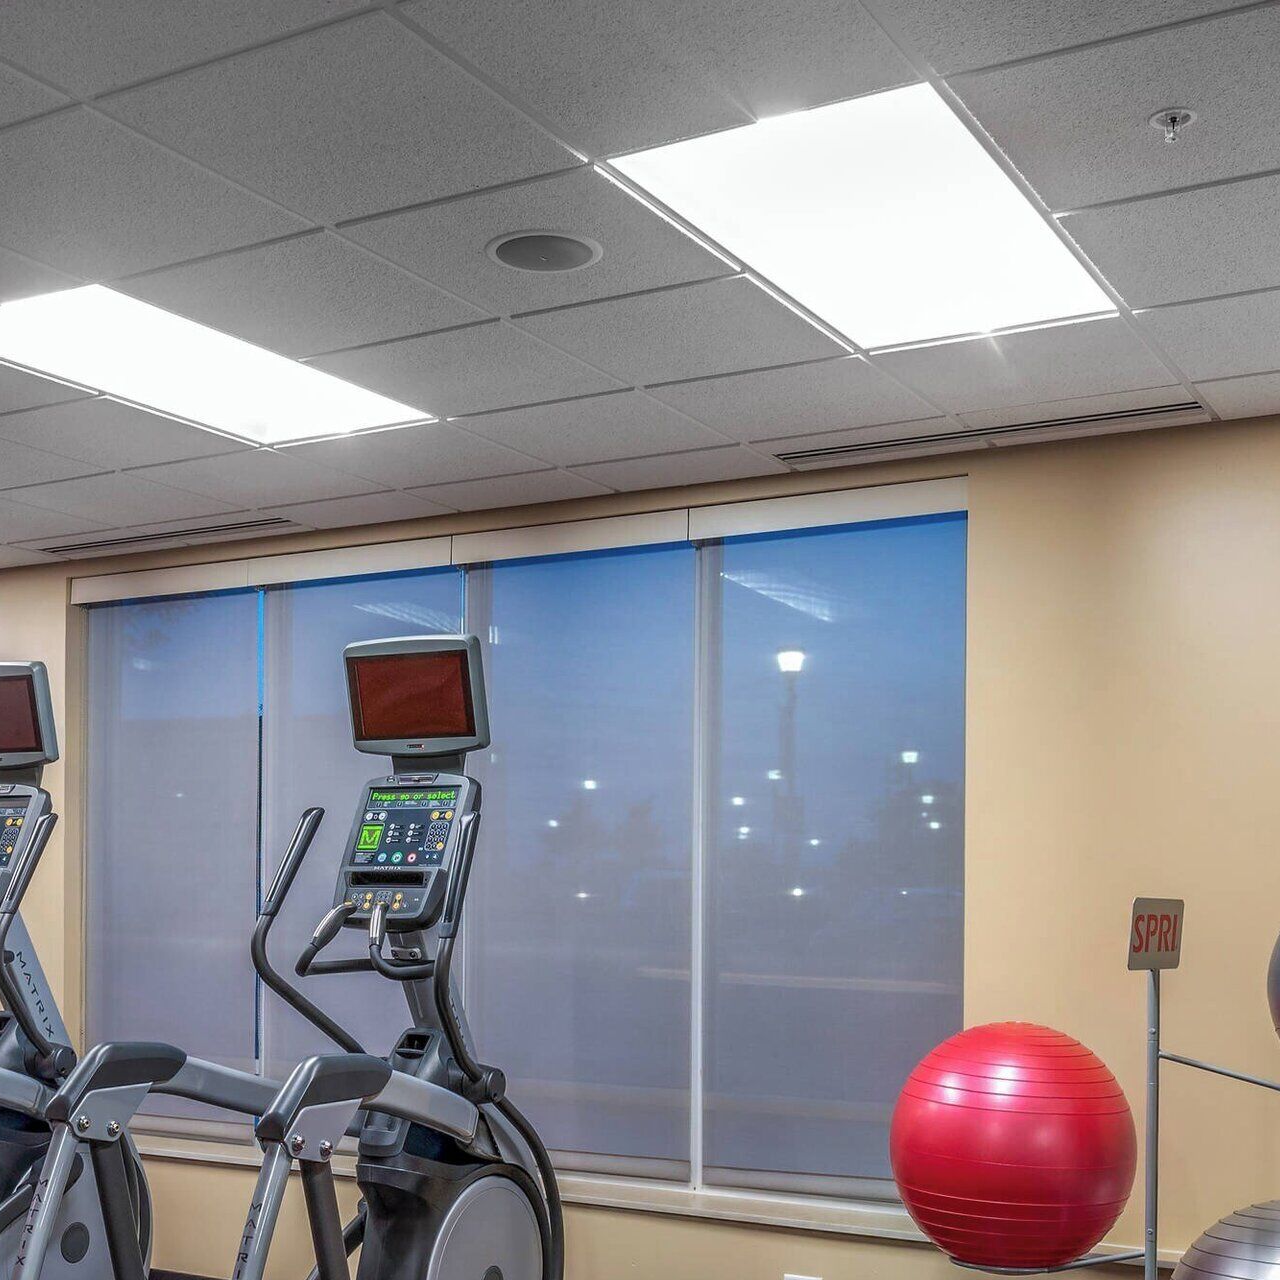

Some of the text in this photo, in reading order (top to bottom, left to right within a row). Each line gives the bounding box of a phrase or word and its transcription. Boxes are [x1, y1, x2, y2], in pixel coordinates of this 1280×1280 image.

[372, 792, 396, 801] Press
[427, 790, 456, 800] select
[1133, 914, 1178, 953] SPRI
[16, 951, 55, 1038] MATRIX
[15, 1179, 49, 1266] MATRIX
